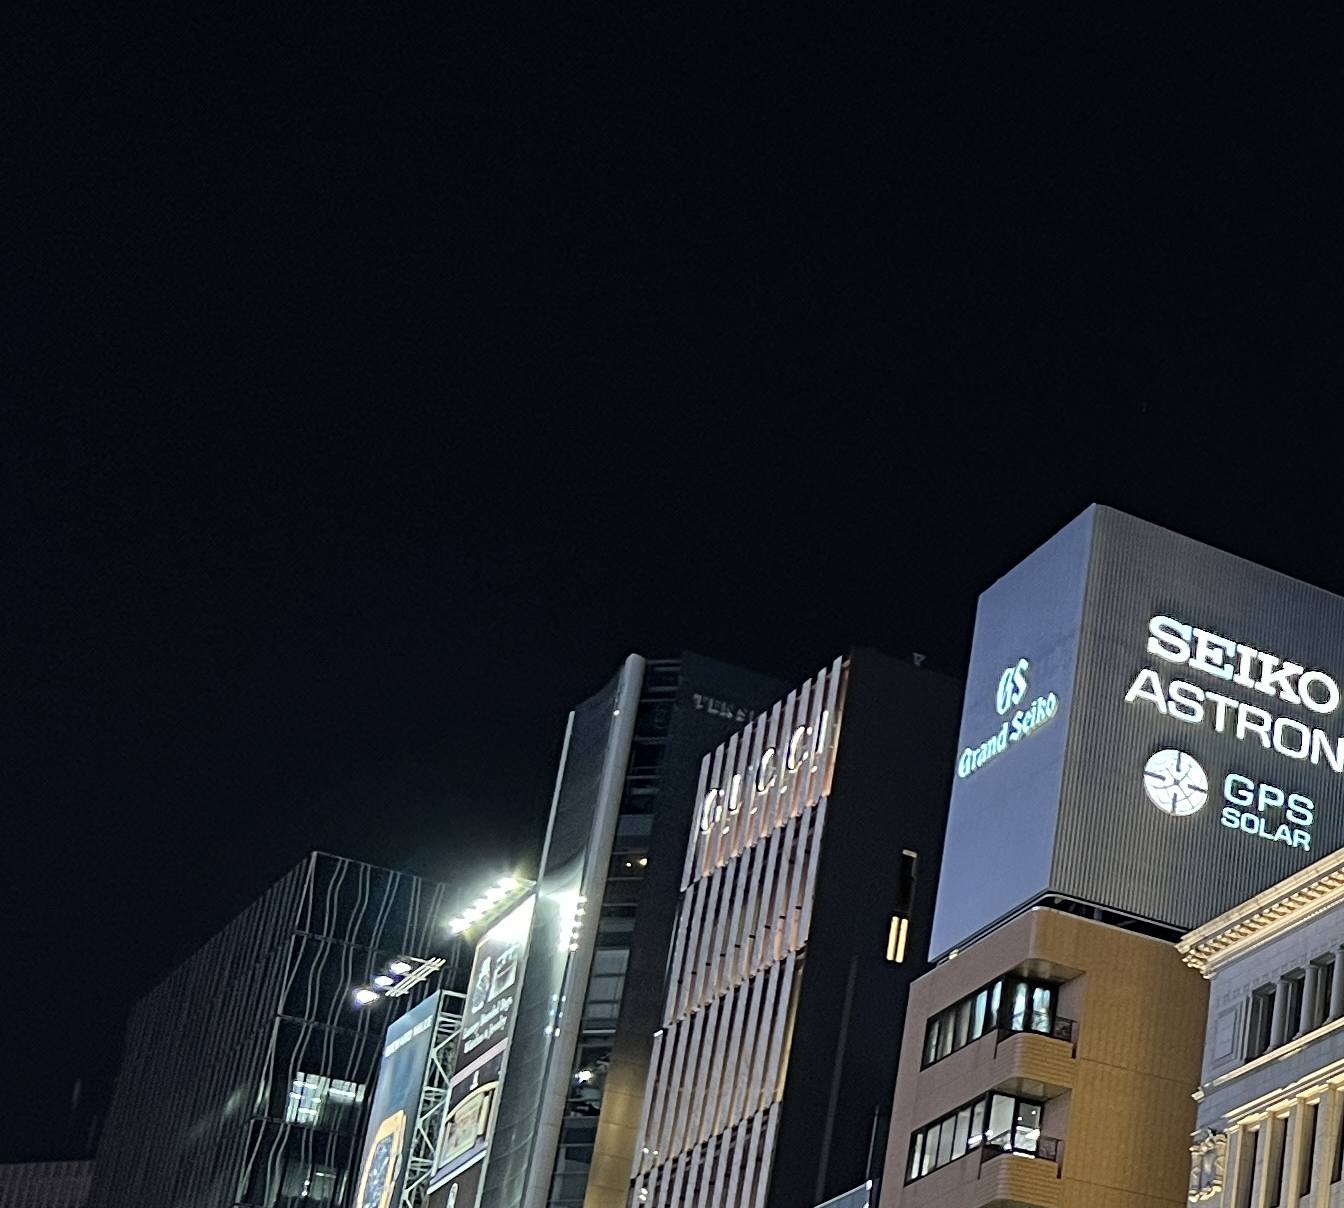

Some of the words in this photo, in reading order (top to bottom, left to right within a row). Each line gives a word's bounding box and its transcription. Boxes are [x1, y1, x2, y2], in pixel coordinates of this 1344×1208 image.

[1148, 614, 1342, 714] SEIKO
[957, 720, 1011, 779] Grand
[1009, 690, 1059, 744] Seiko
[1220, 806, 1313, 852] SOLAR
[1223, 773, 1315, 826] GPS
